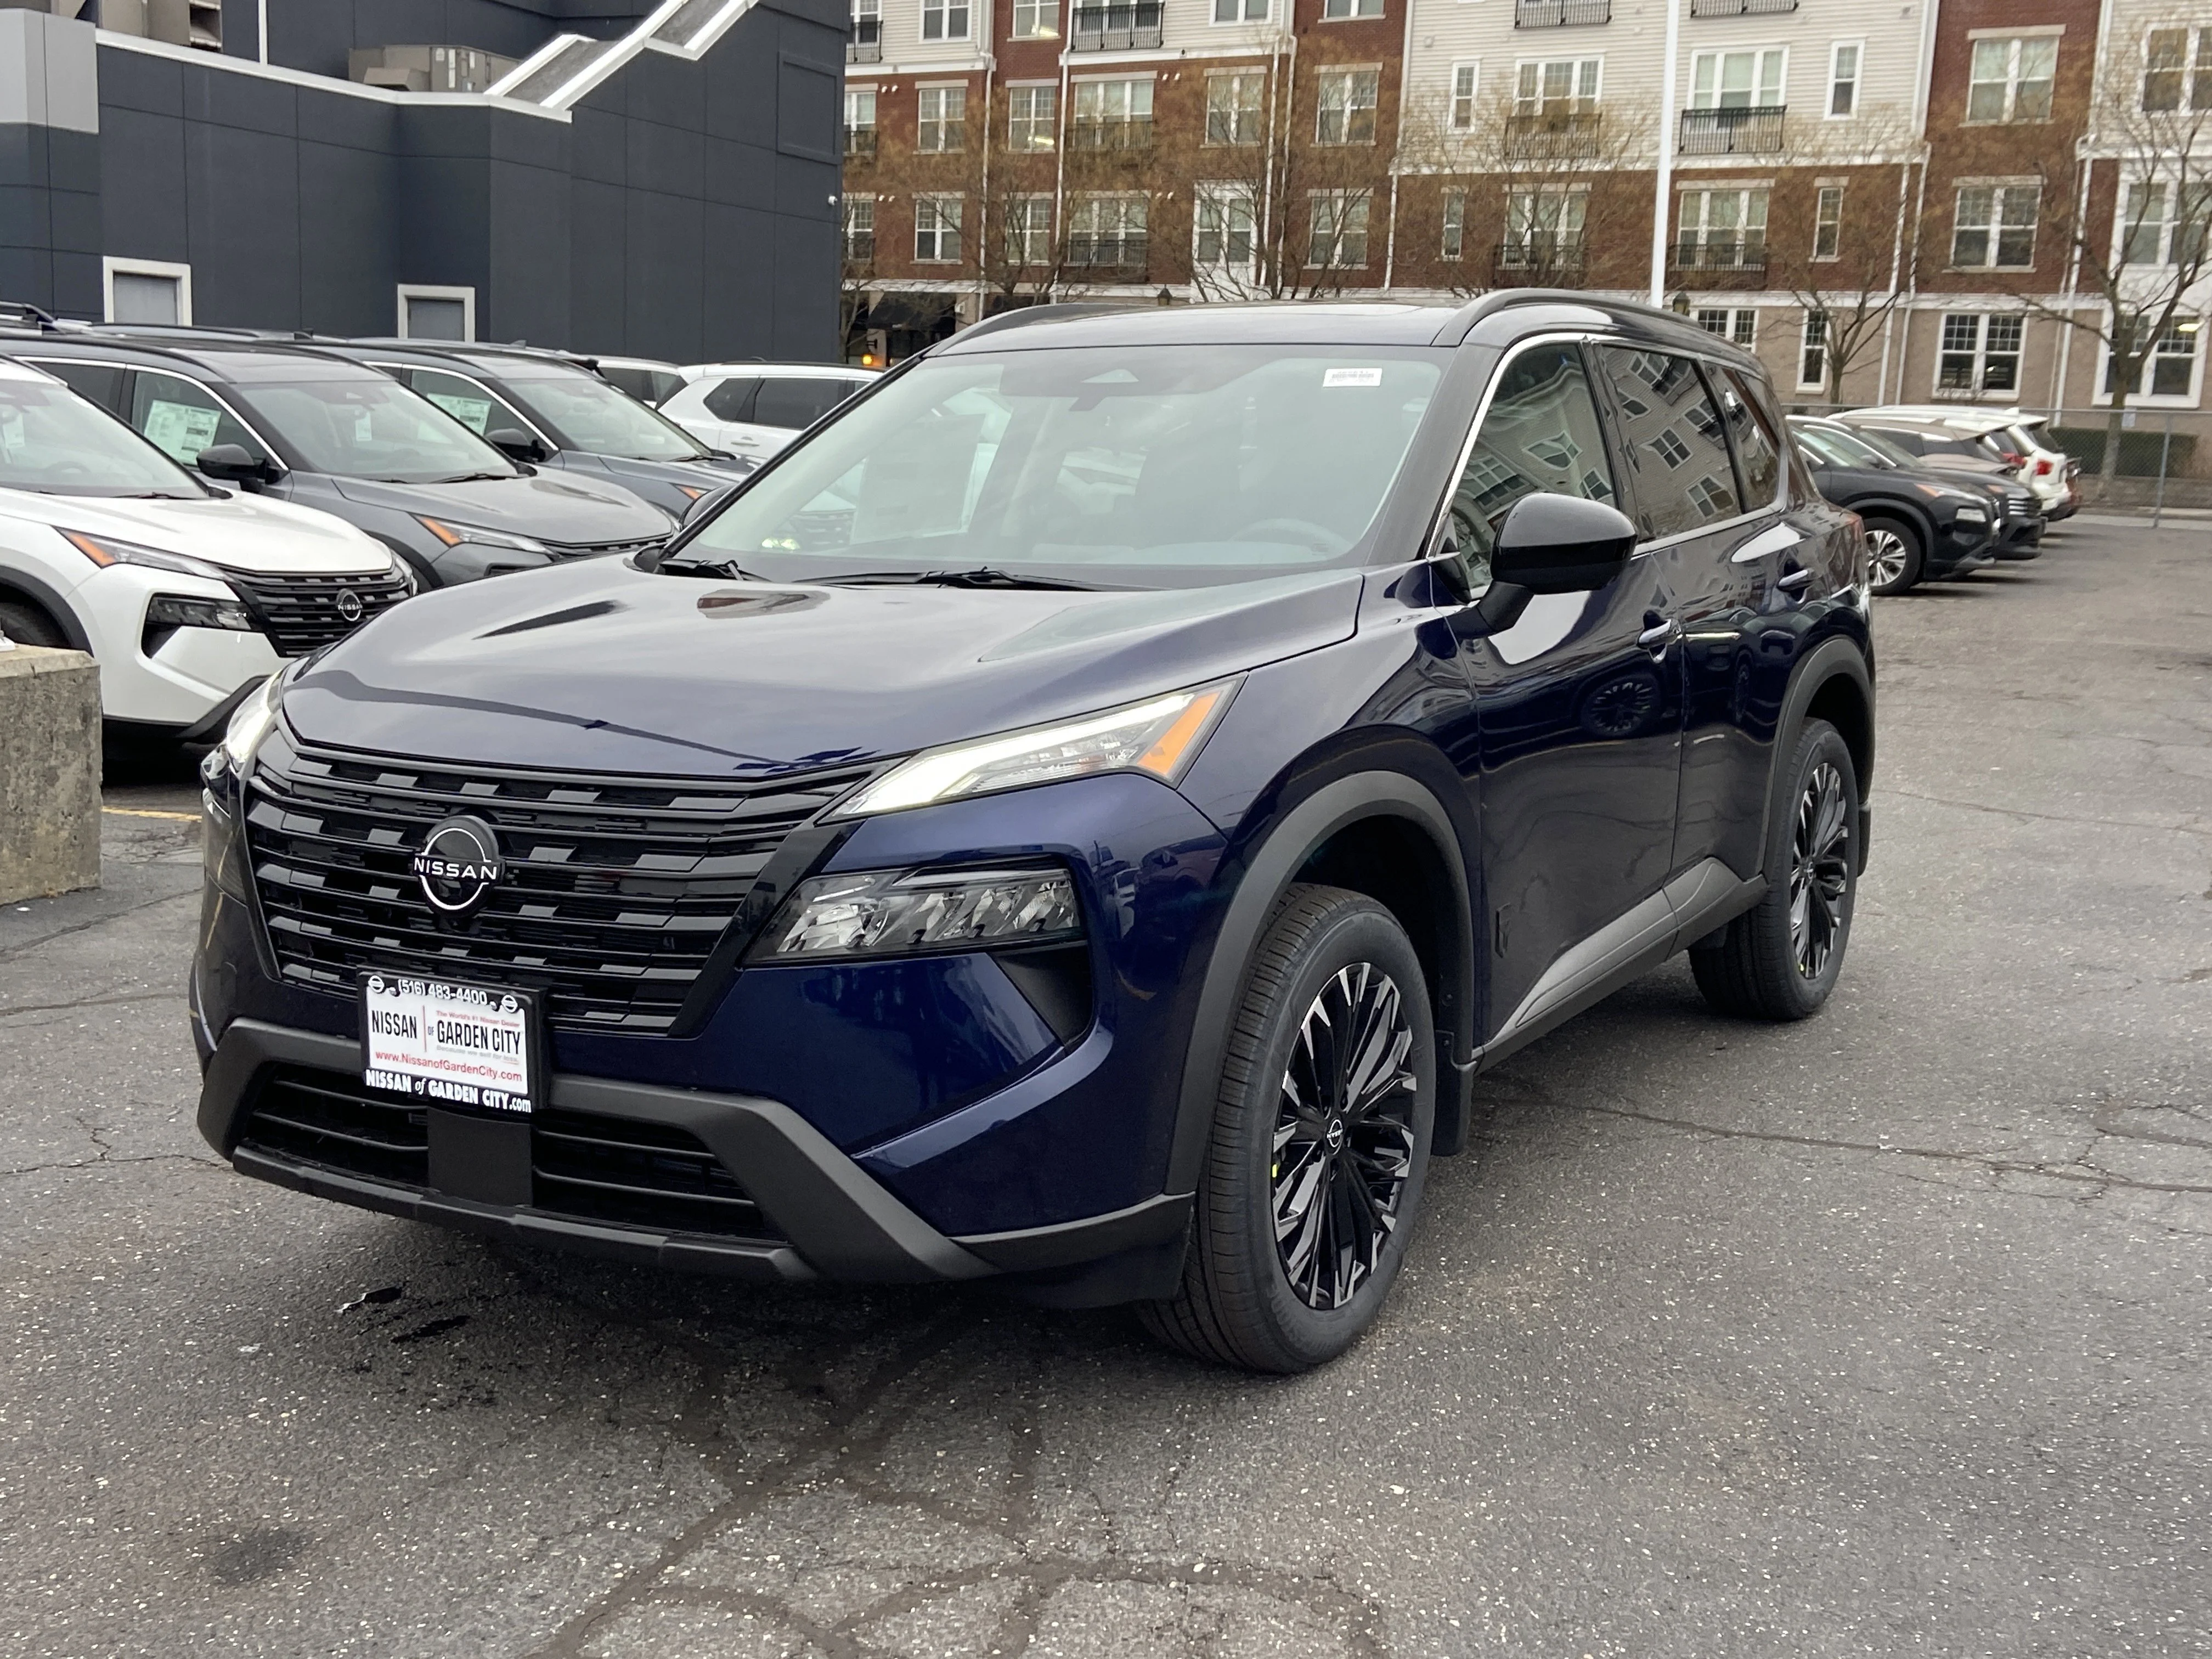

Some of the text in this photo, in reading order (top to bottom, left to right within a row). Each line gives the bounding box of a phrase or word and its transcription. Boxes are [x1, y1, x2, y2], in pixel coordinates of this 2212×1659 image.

[414, 857, 497, 880] NISSAN
[398, 979, 488, 1006] (516) 483-4400
[371, 1010, 417, 1039] NISSAN
[437, 1019, 489, 1049] GARDEN
[492, 1028, 521, 1054] CITY
[375, 1051, 523, 1082] www.NissanofGardenCity.com
[366, 1069, 532, 1113] NISSAN of GARDEN CITY.com
